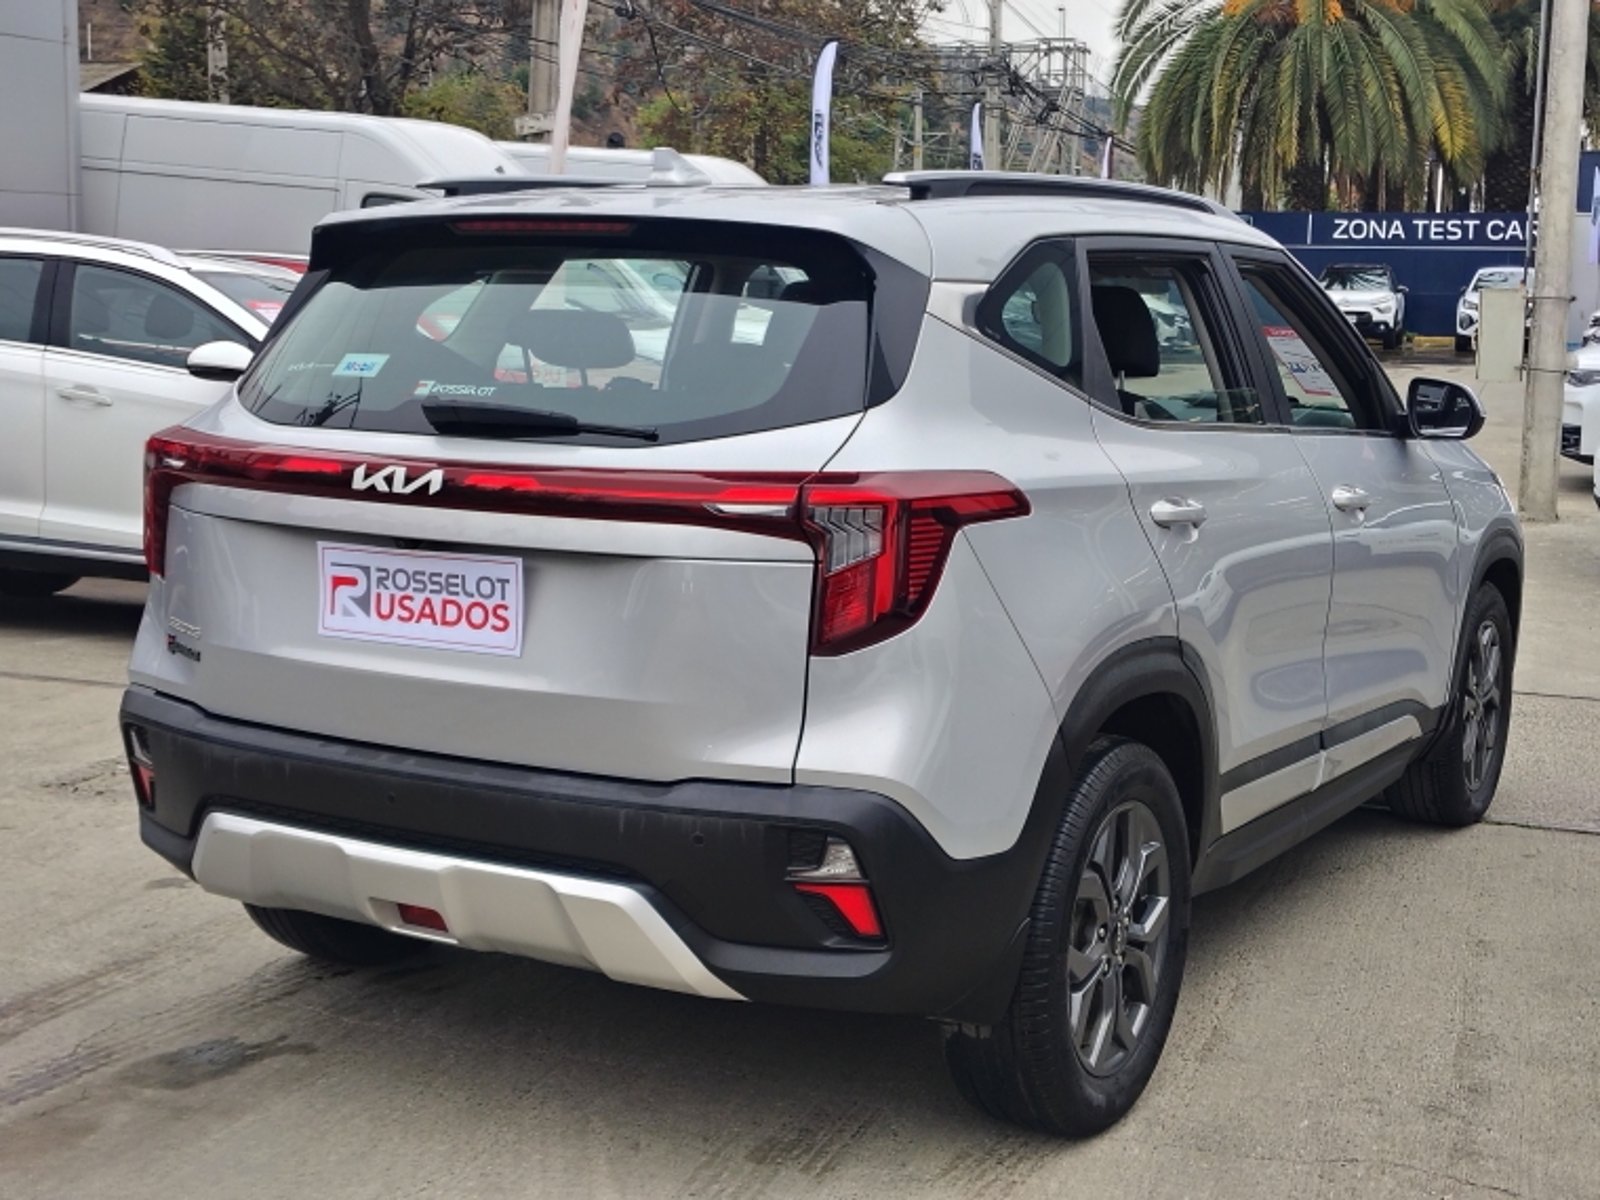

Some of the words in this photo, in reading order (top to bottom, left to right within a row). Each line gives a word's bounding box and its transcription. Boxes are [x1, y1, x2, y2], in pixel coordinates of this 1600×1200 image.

[1332, 219, 1405, 240] ZONA
[1412, 219, 1480, 240] TEST
[351, 463, 444, 495] KIA
[375, 567, 510, 600] ROSSELOT
[375, 592, 510, 632] USADOS
